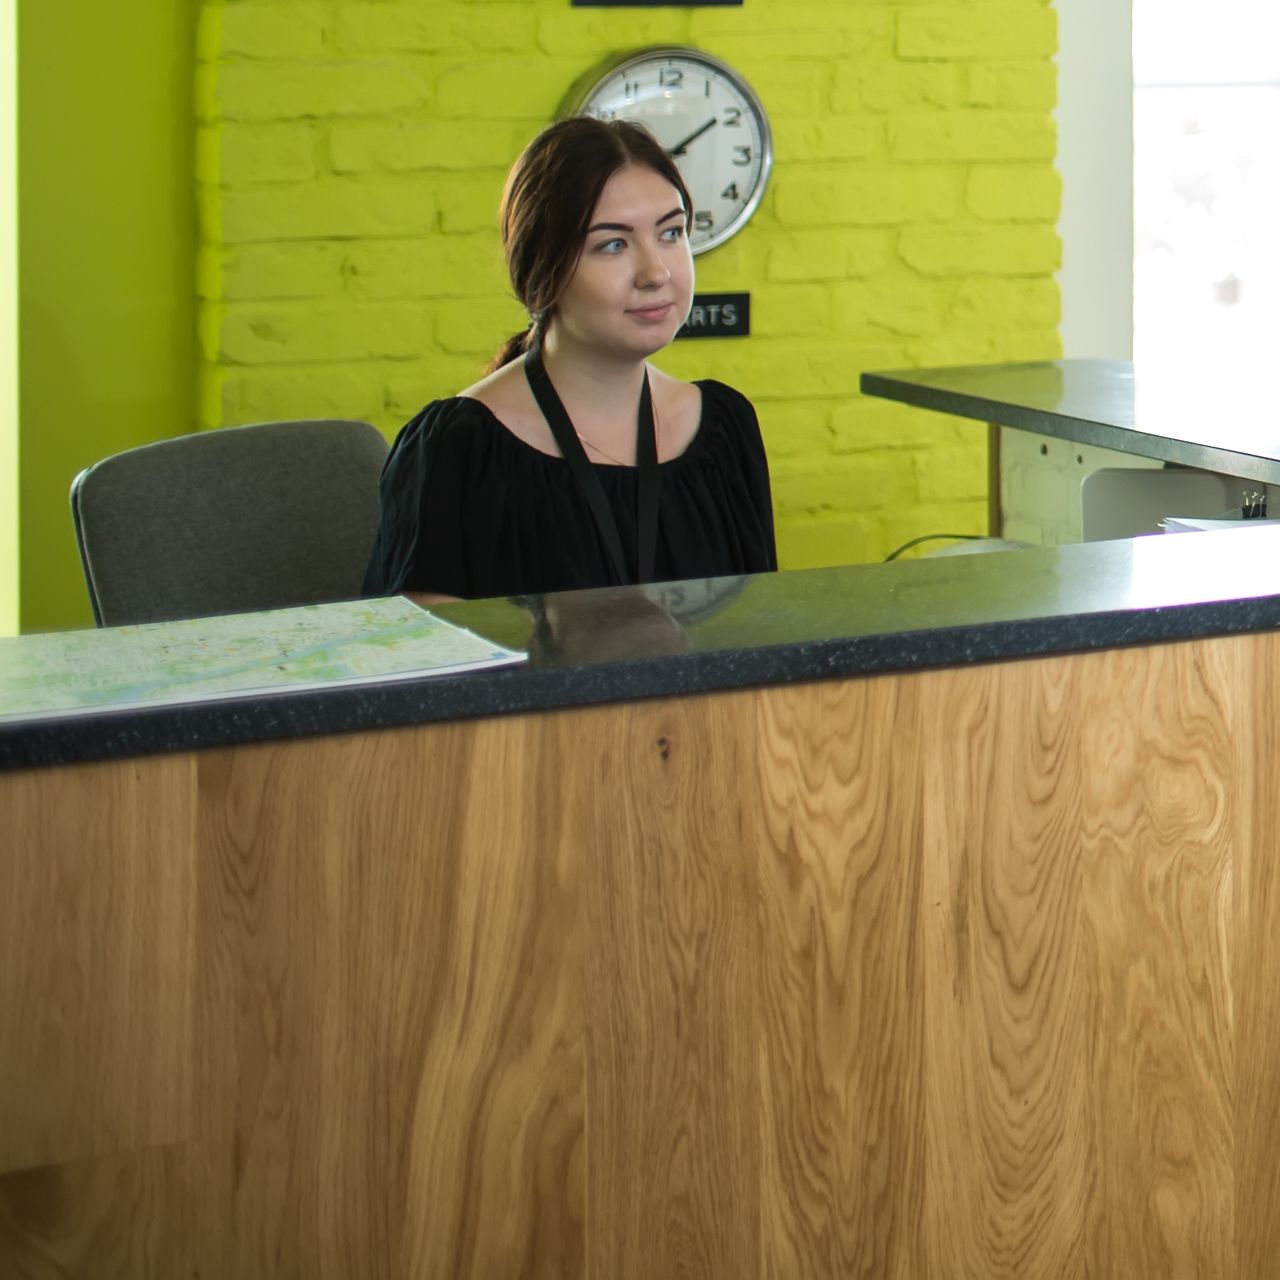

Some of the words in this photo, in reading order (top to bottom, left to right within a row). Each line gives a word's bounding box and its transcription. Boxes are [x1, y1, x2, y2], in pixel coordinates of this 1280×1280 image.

[659, 69, 684, 89] 12
[625, 81, 638, 99] 11
[722, 107, 741, 128] 2
[731, 146, 751, 166] 3
[721, 183, 739, 202] 4
[695, 211, 713, 231] 5
